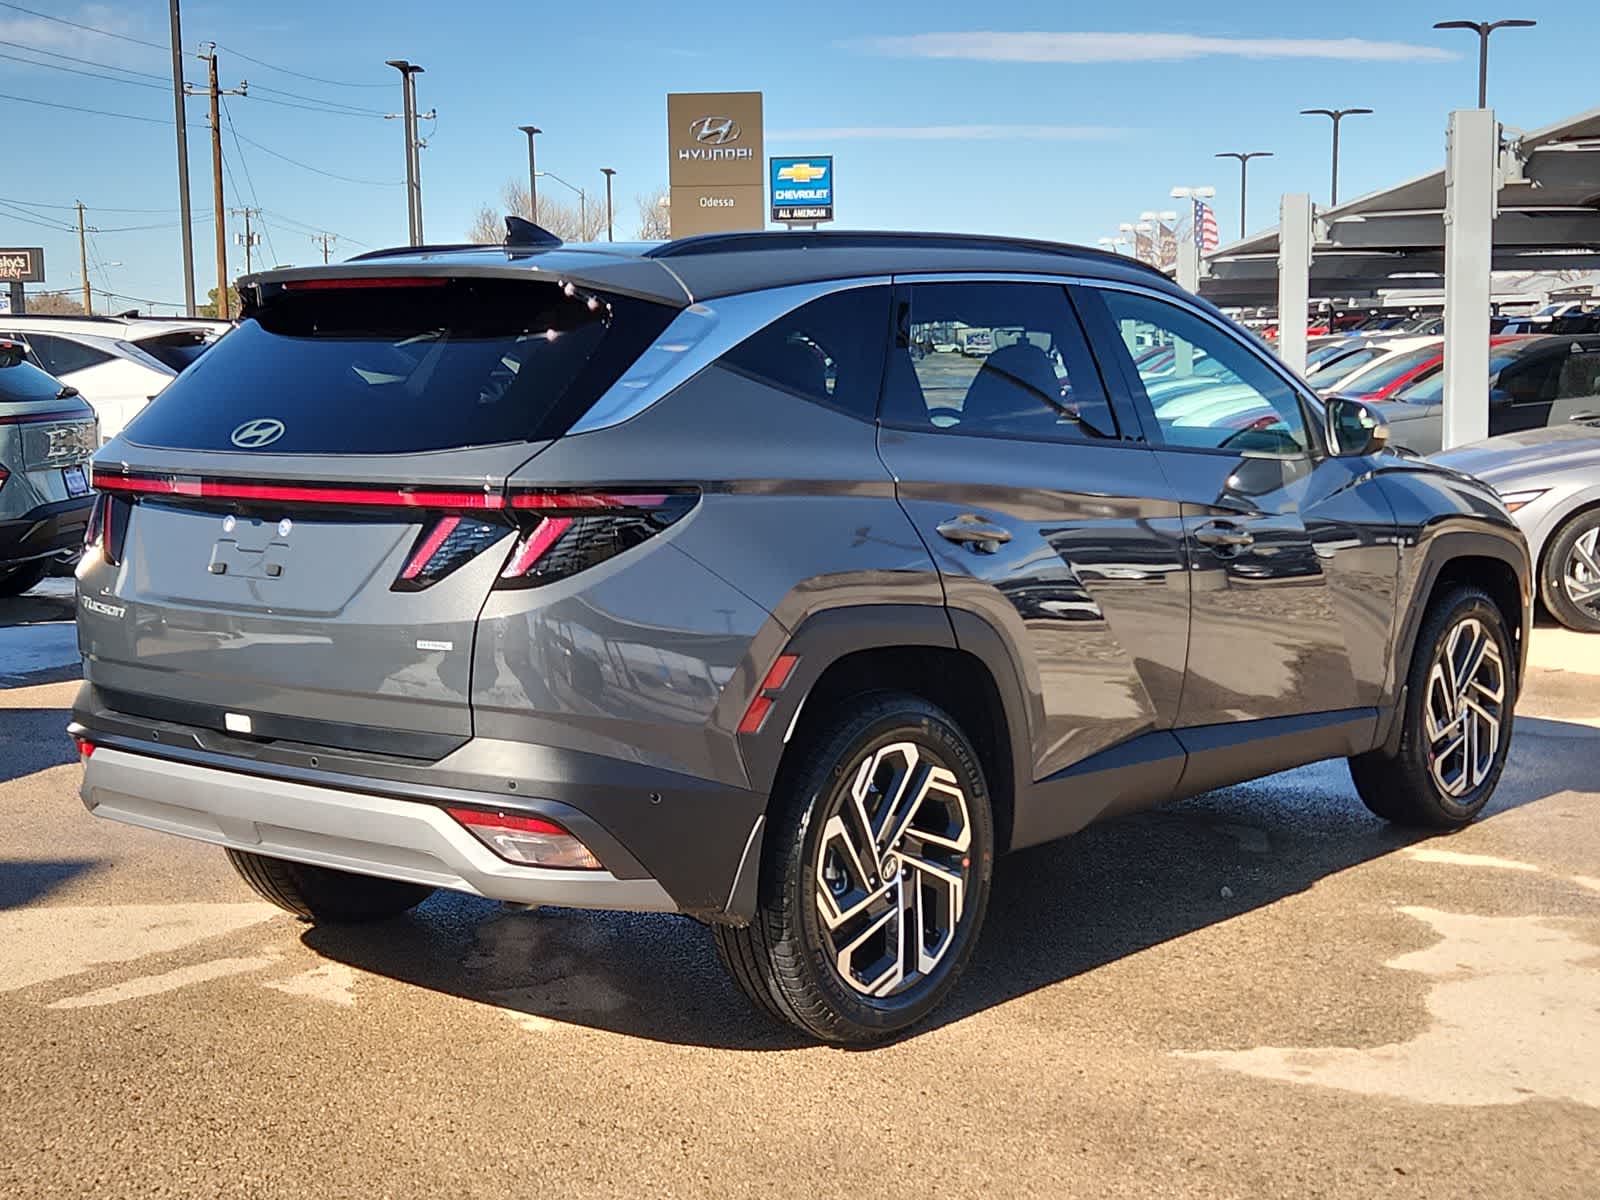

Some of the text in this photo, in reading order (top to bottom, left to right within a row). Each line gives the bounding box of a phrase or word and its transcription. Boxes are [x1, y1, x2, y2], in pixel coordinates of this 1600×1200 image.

[679, 148, 753, 160] HYUNDAI
[775, 190, 829, 200] CHEVROLET
[700, 197, 735, 207] Odessa
[778, 208, 792, 219] ALL
[82, 595, 126, 618] TUCSON
